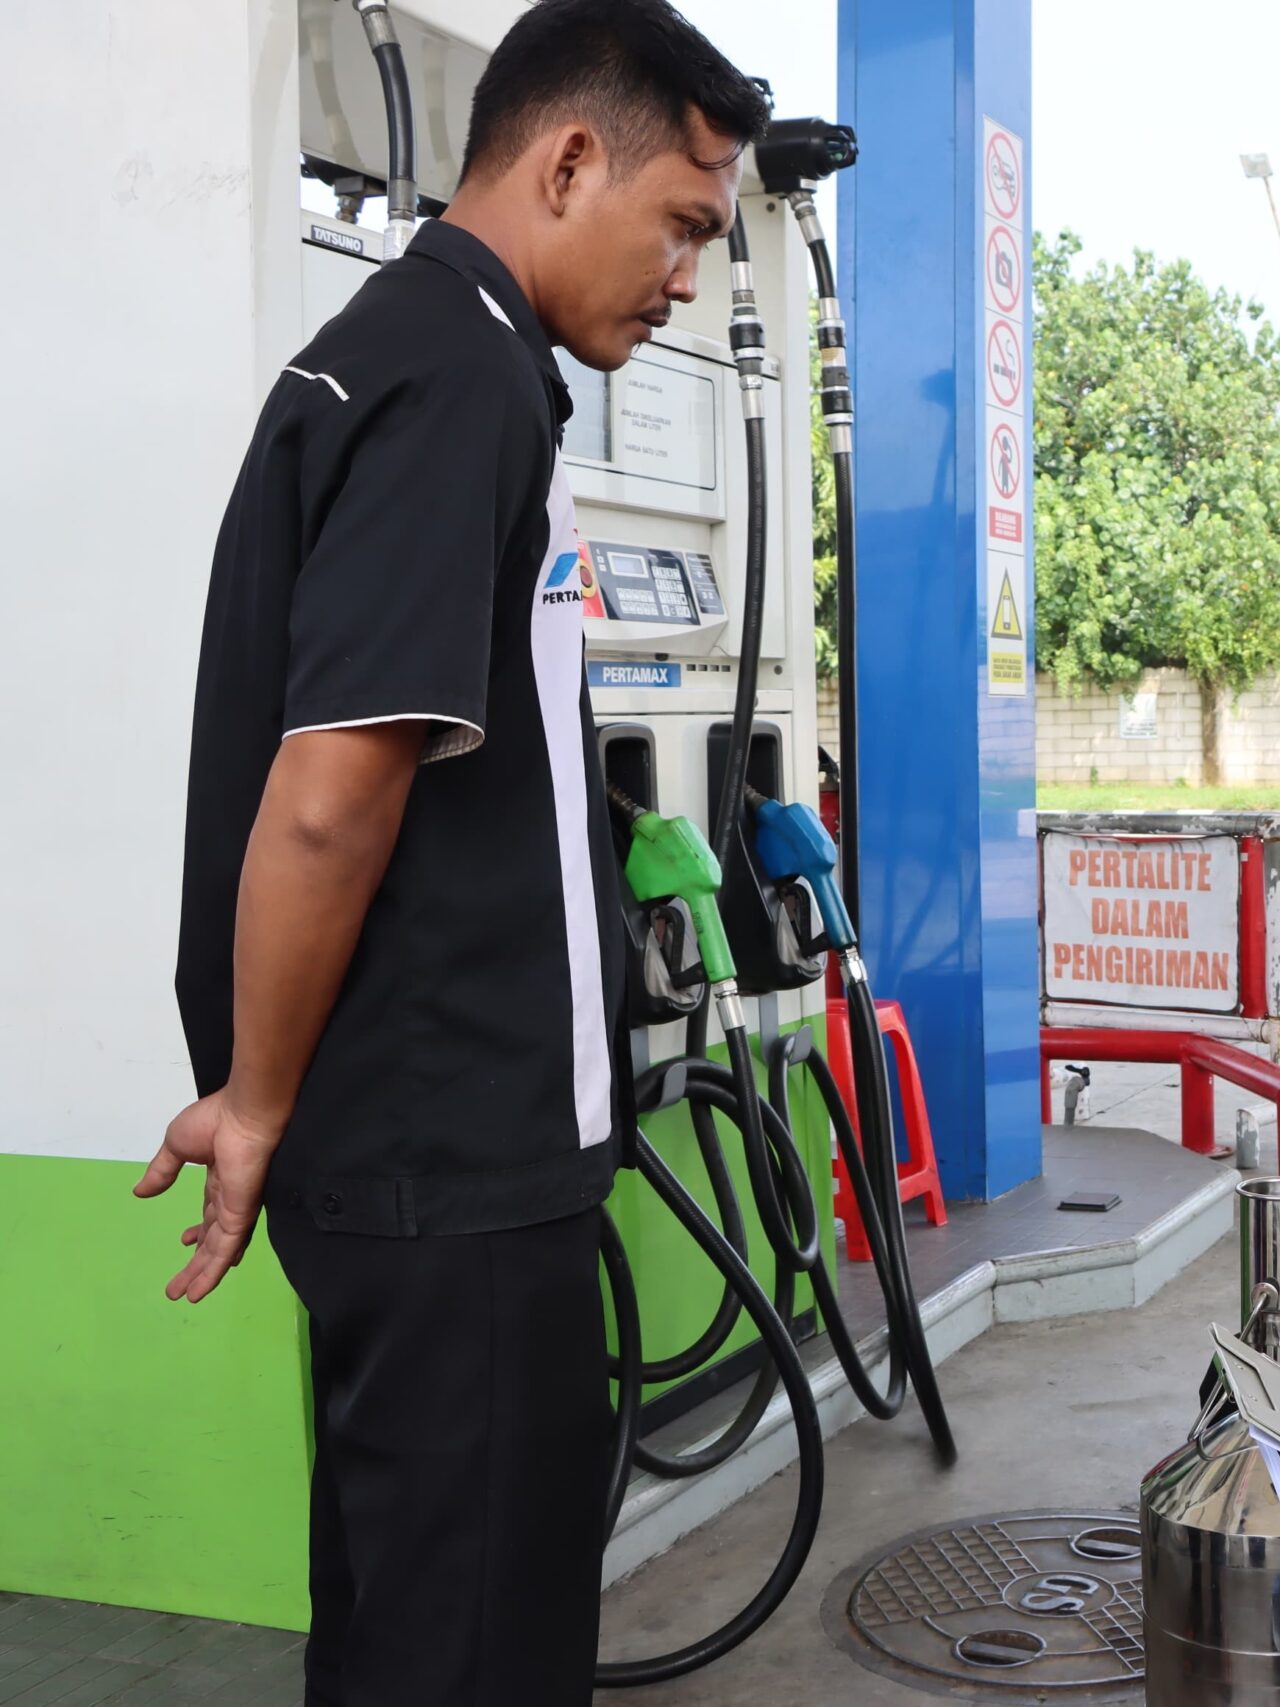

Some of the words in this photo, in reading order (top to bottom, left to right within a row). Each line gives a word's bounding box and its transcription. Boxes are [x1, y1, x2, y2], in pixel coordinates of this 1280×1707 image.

[313, 226, 362, 252] TATSUNO
[542, 590, 583, 605] PERTA
[603, 667, 668, 683] PERTAMAX
[1069, 850, 1212, 891] PERTALITE
[1092, 897, 1189, 939] DALAM
[1053, 943, 1229, 991] PENGIRIMAN
